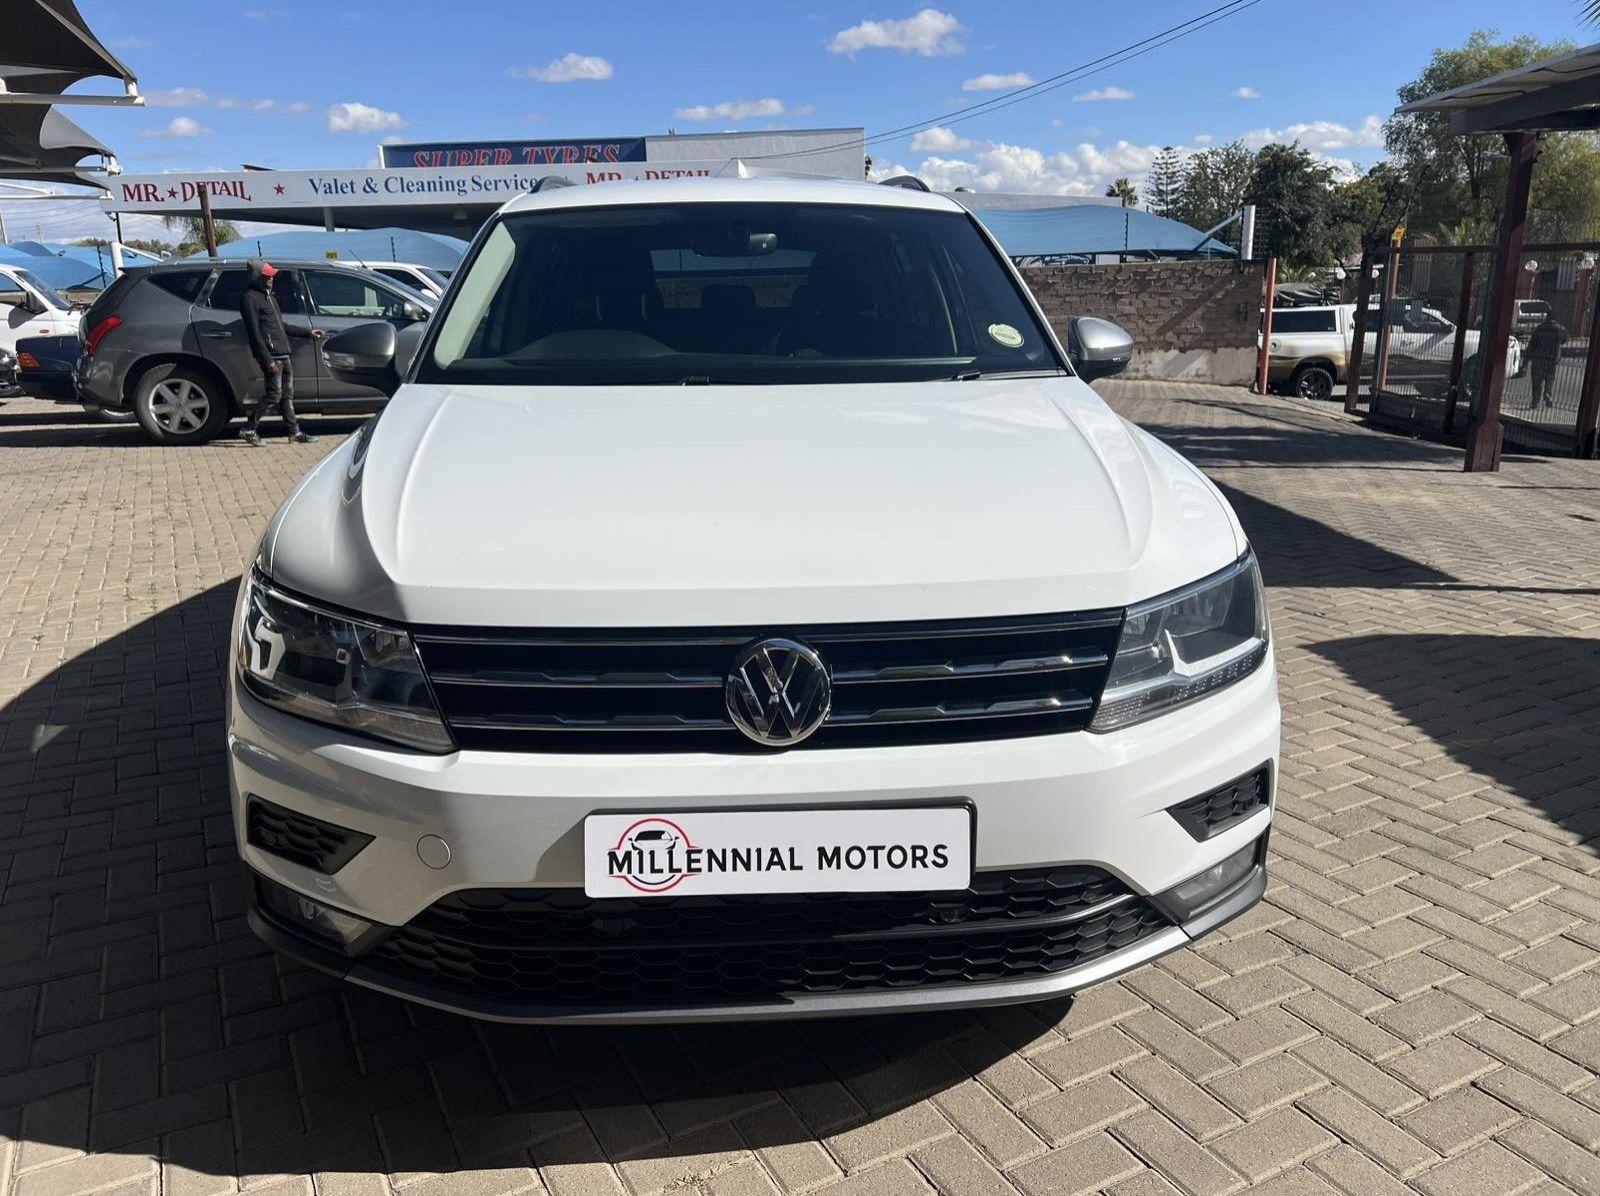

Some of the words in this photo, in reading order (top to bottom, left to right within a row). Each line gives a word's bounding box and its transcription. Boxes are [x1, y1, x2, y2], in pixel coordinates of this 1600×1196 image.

[414, 148, 513, 168] SUPER
[121, 183, 165, 202] MR.
[308, 177, 356, 195] Valet
[362, 177, 378, 194] &
[384, 175, 468, 196] Cleaning
[607, 846, 803, 875] MILLENNIAL
[816, 843, 949, 870] MOTORS
